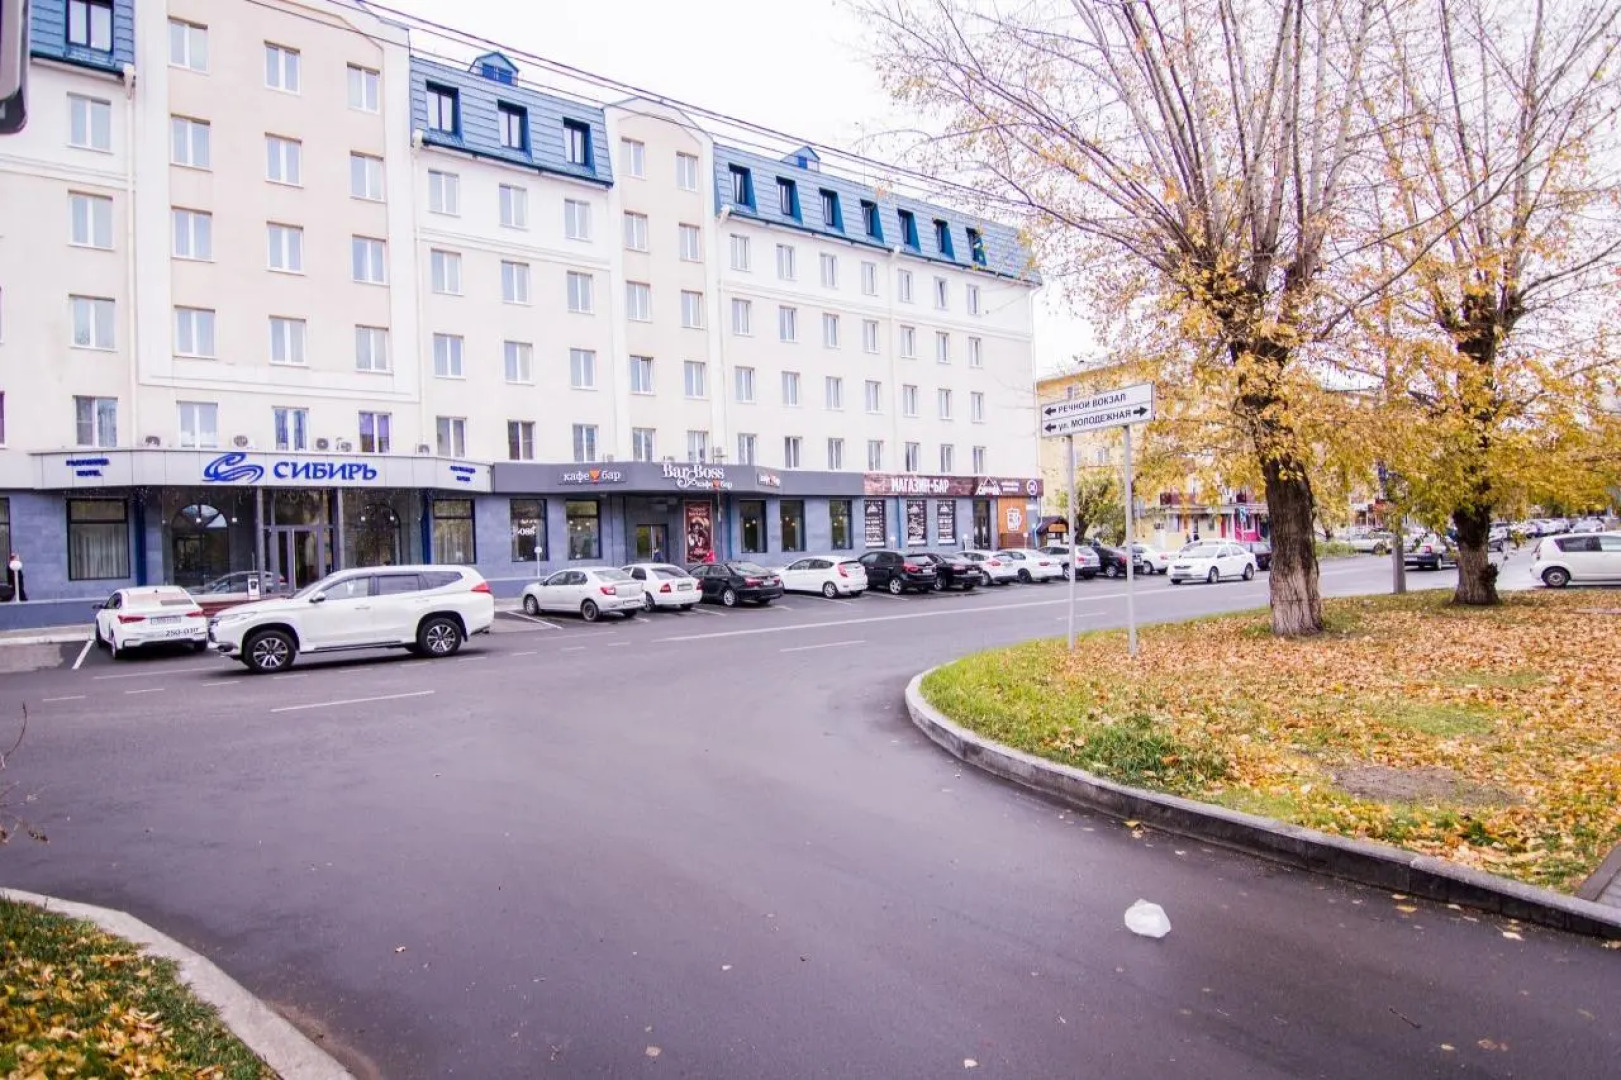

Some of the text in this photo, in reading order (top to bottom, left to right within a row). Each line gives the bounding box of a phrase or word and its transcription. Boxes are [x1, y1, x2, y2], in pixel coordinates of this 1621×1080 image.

[1092, 393, 1126, 407] ВОКЗАЛ
[1071, 409, 1132, 427] МОЛОДЕЖНАЯ
[273, 461, 377, 481] СИБИРЬ
[564, 470, 621, 483] кафе бар
[662, 463, 725, 480] Bar Boss
